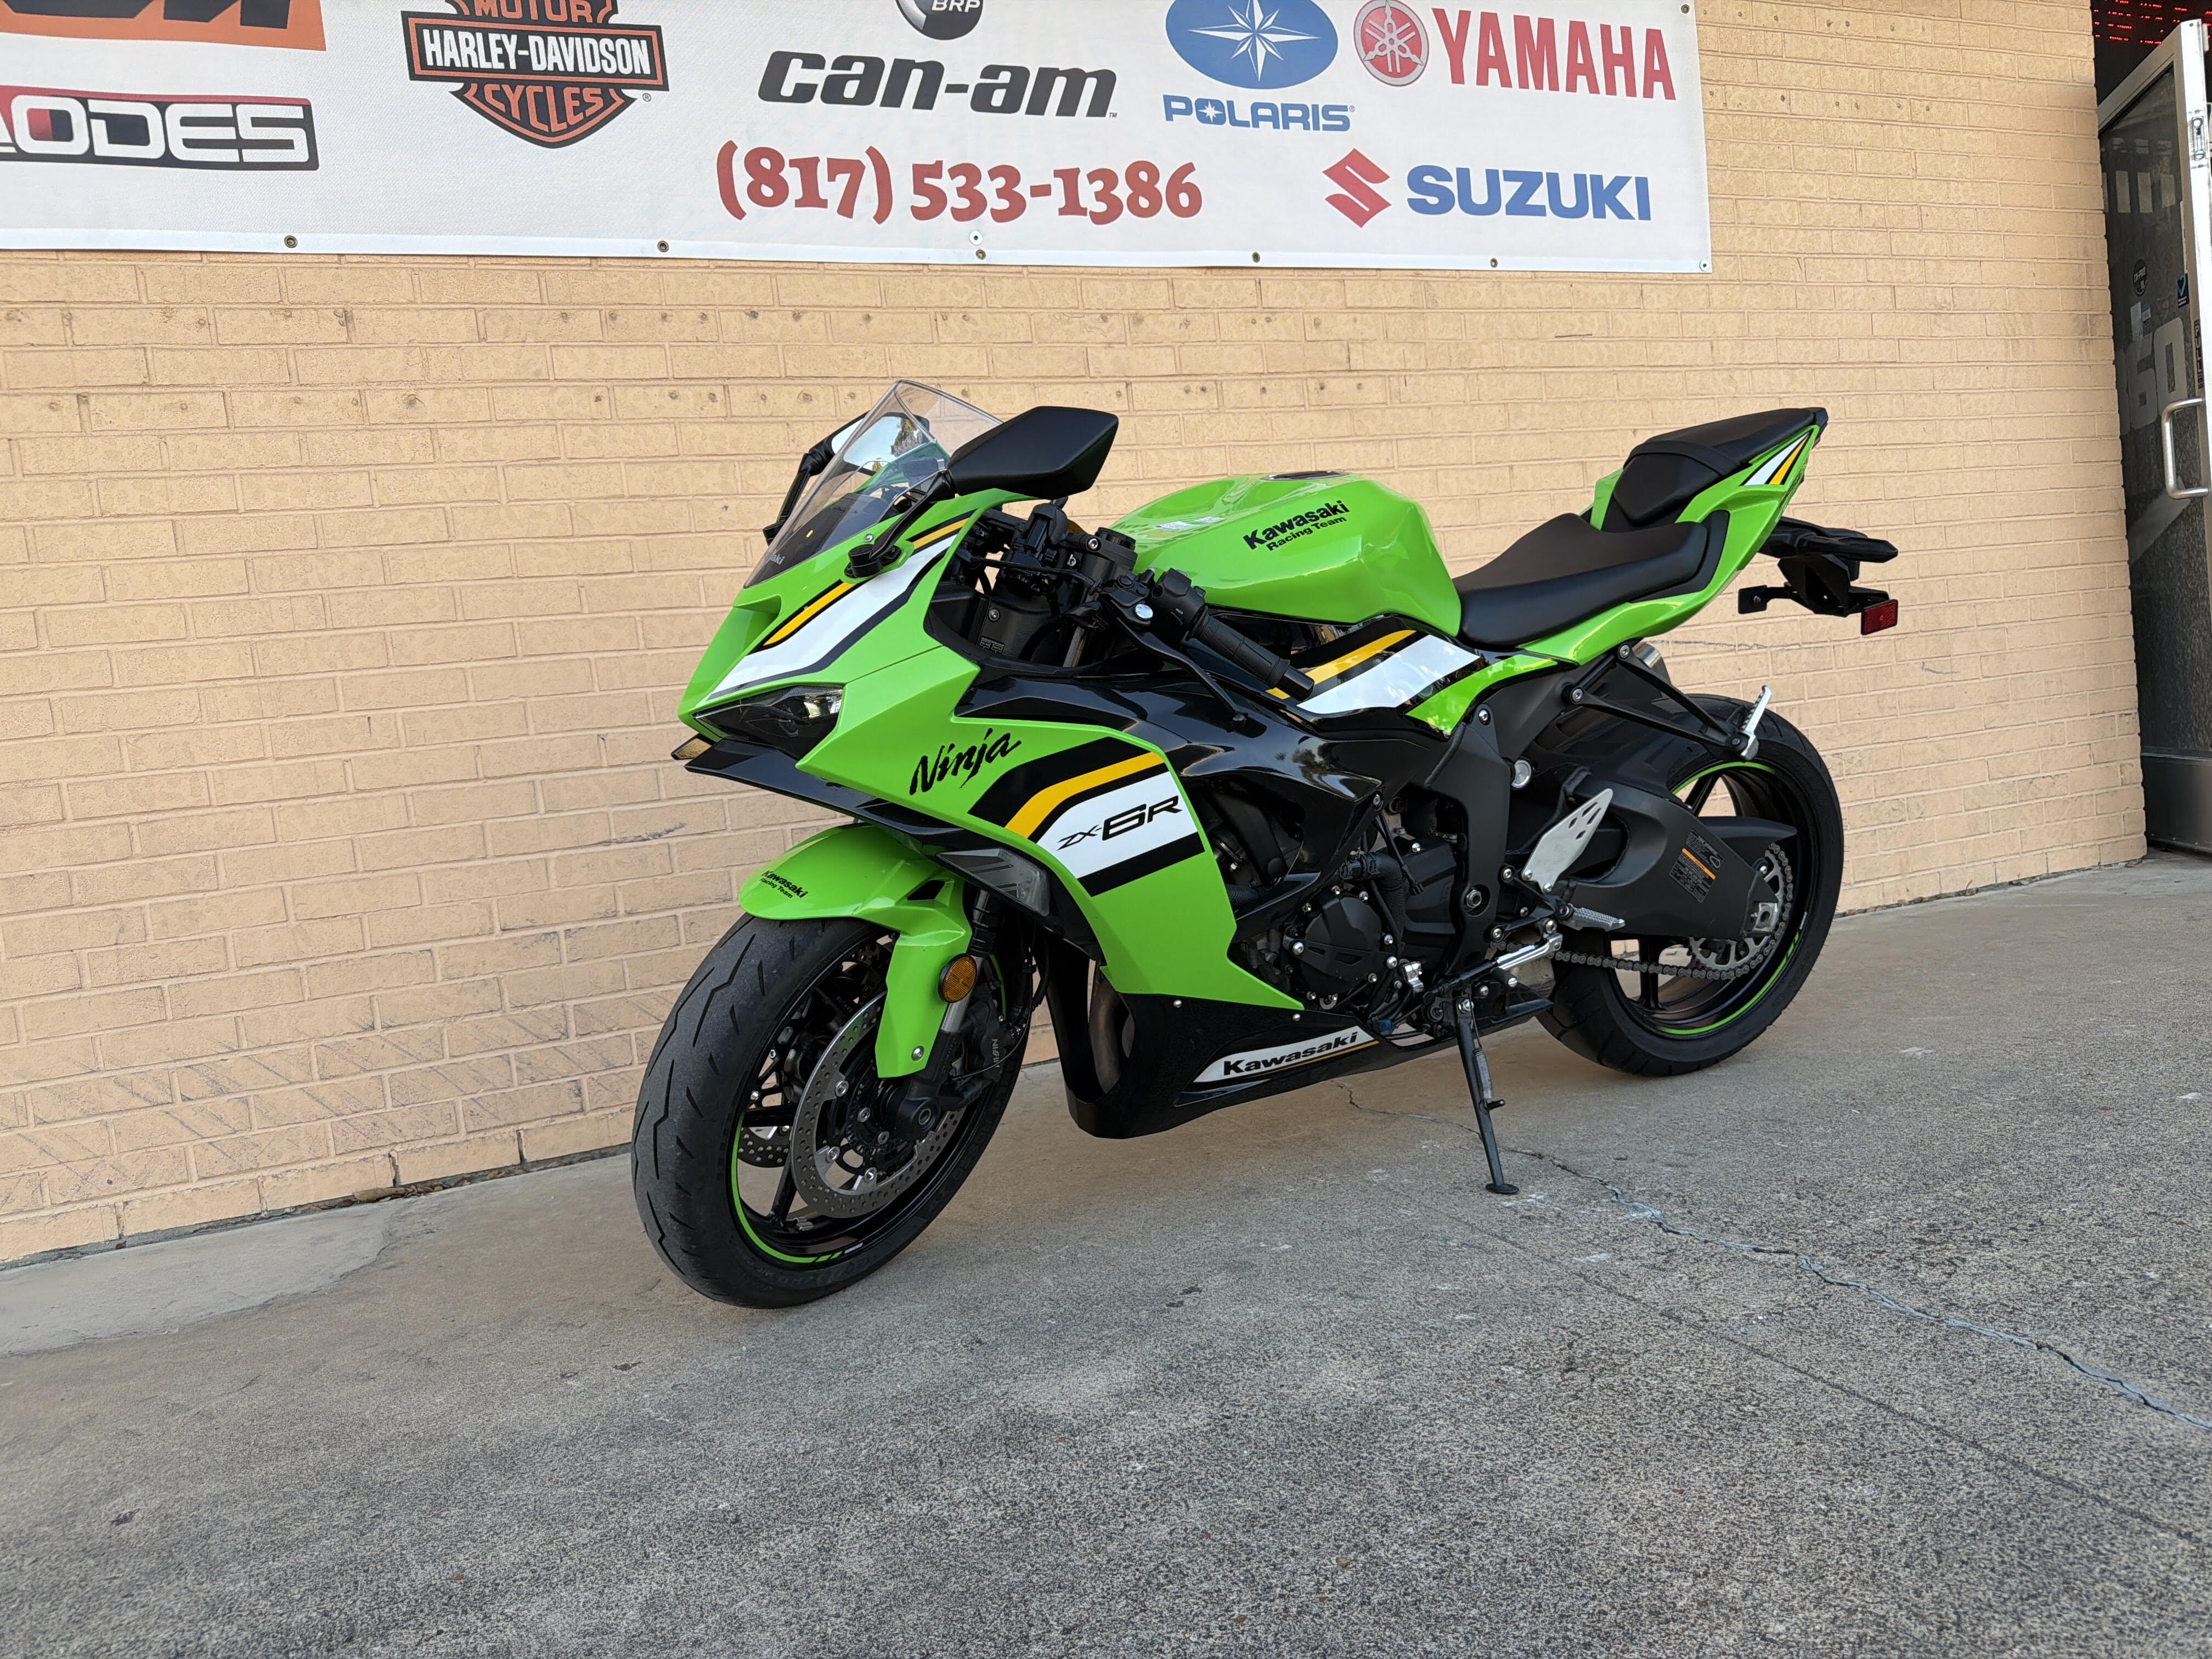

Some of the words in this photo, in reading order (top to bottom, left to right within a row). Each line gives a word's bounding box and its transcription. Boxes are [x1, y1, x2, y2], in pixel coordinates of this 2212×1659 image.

[932, 0, 980, 13] BRP
[422, 29, 651, 75] HARLEY-DAVIDSON
[1431, 8, 1677, 101] YAMAHA
[484, 83, 603, 132] CYCLES
[758, 50, 1117, 118] can-am
[0, 95, 309, 162] ODES
[1163, 94, 1352, 131] POLARIS
[716, 140, 893, 224] (817)
[911, 160, 1203, 225] 533-1386
[1407, 165, 1651, 221] SUZUKI
[2117, 317, 2187, 435] 60
[1243, 500, 1350, 550] Kawasaki
[1266, 528, 1313, 551] Racing
[1311, 517, 1347, 529] Team
[910, 729, 1022, 795] Ninja
[1057, 795, 1182, 850] ZX-6R
[761, 871, 808, 898] Kawasaki
[778, 886, 793, 898] Team
[1223, 1032, 1358, 1076] Kawasaki
